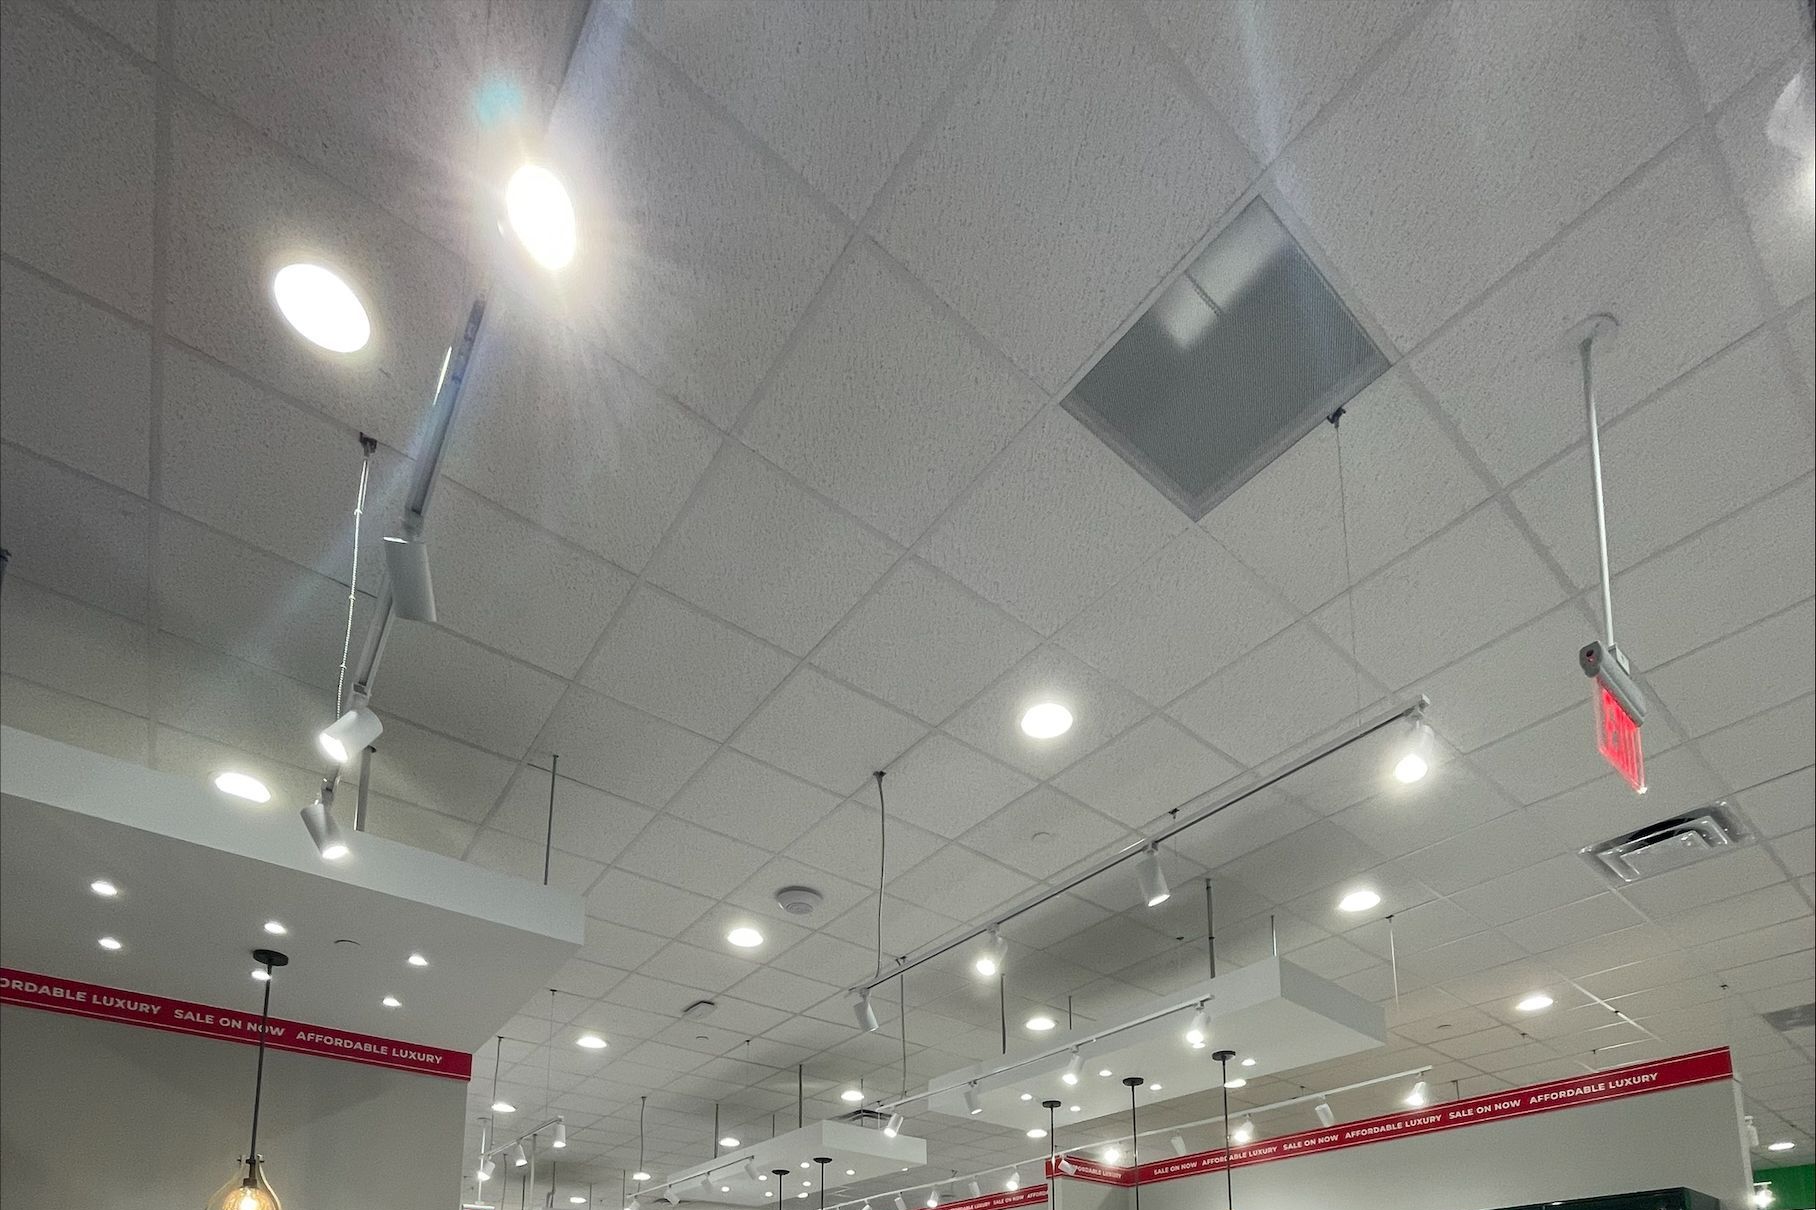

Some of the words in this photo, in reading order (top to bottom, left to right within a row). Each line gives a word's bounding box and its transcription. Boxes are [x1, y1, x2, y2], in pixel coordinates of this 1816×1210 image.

[92, 994, 161, 1015] LUXURY
[174, 1009, 214, 1024] SALE
[219, 1017, 242, 1029] ON
[247, 1022, 285, 1037] NOW
[296, 1031, 388, 1055] AFFORDABLE
[392, 1047, 443, 1064] LUXURY
[1153, 1167, 1169, 1175] SALE
[1181, 1161, 1198, 1170] NOW
[1248, 1146, 1278, 1158] LUXURY
[1282, 1141, 1303, 1151] SALE
[1304, 1139, 1317, 1147] ON
[1317, 1134, 1339, 1145] NOW
[1344, 1122, 1403, 1139] AFFORDABLE
[1404, 1114, 1442, 1128] LUXURY
[1449, 1108, 1474, 1120] SALE
[1476, 1104, 1492, 1114] ON
[1494, 1099, 1522, 1111] NOW
[1529, 1083, 1606, 1105] AFFORDABLE
[1608, 1072, 1659, 1089] LUXURY
